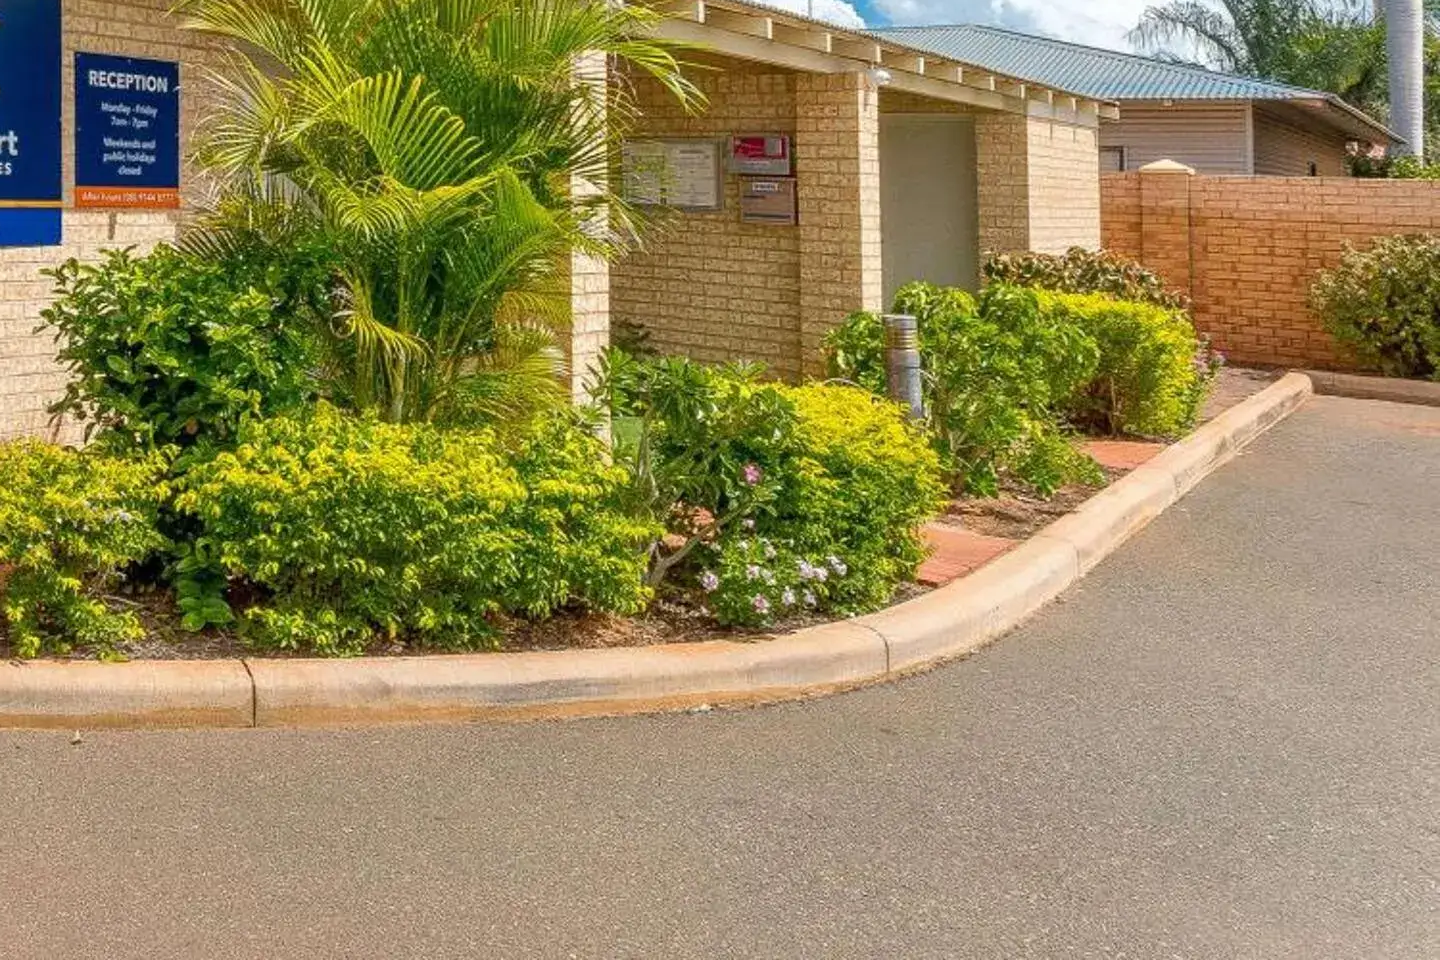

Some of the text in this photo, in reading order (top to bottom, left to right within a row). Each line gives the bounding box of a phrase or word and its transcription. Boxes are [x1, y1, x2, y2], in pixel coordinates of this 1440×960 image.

[88, 70, 168, 93] RECEPTION
[101, 102, 131, 115] Monday
[136, 105, 158, 118] Friday
[132, 118, 148, 129] 7pm
[102, 151, 156, 164] public holidays
